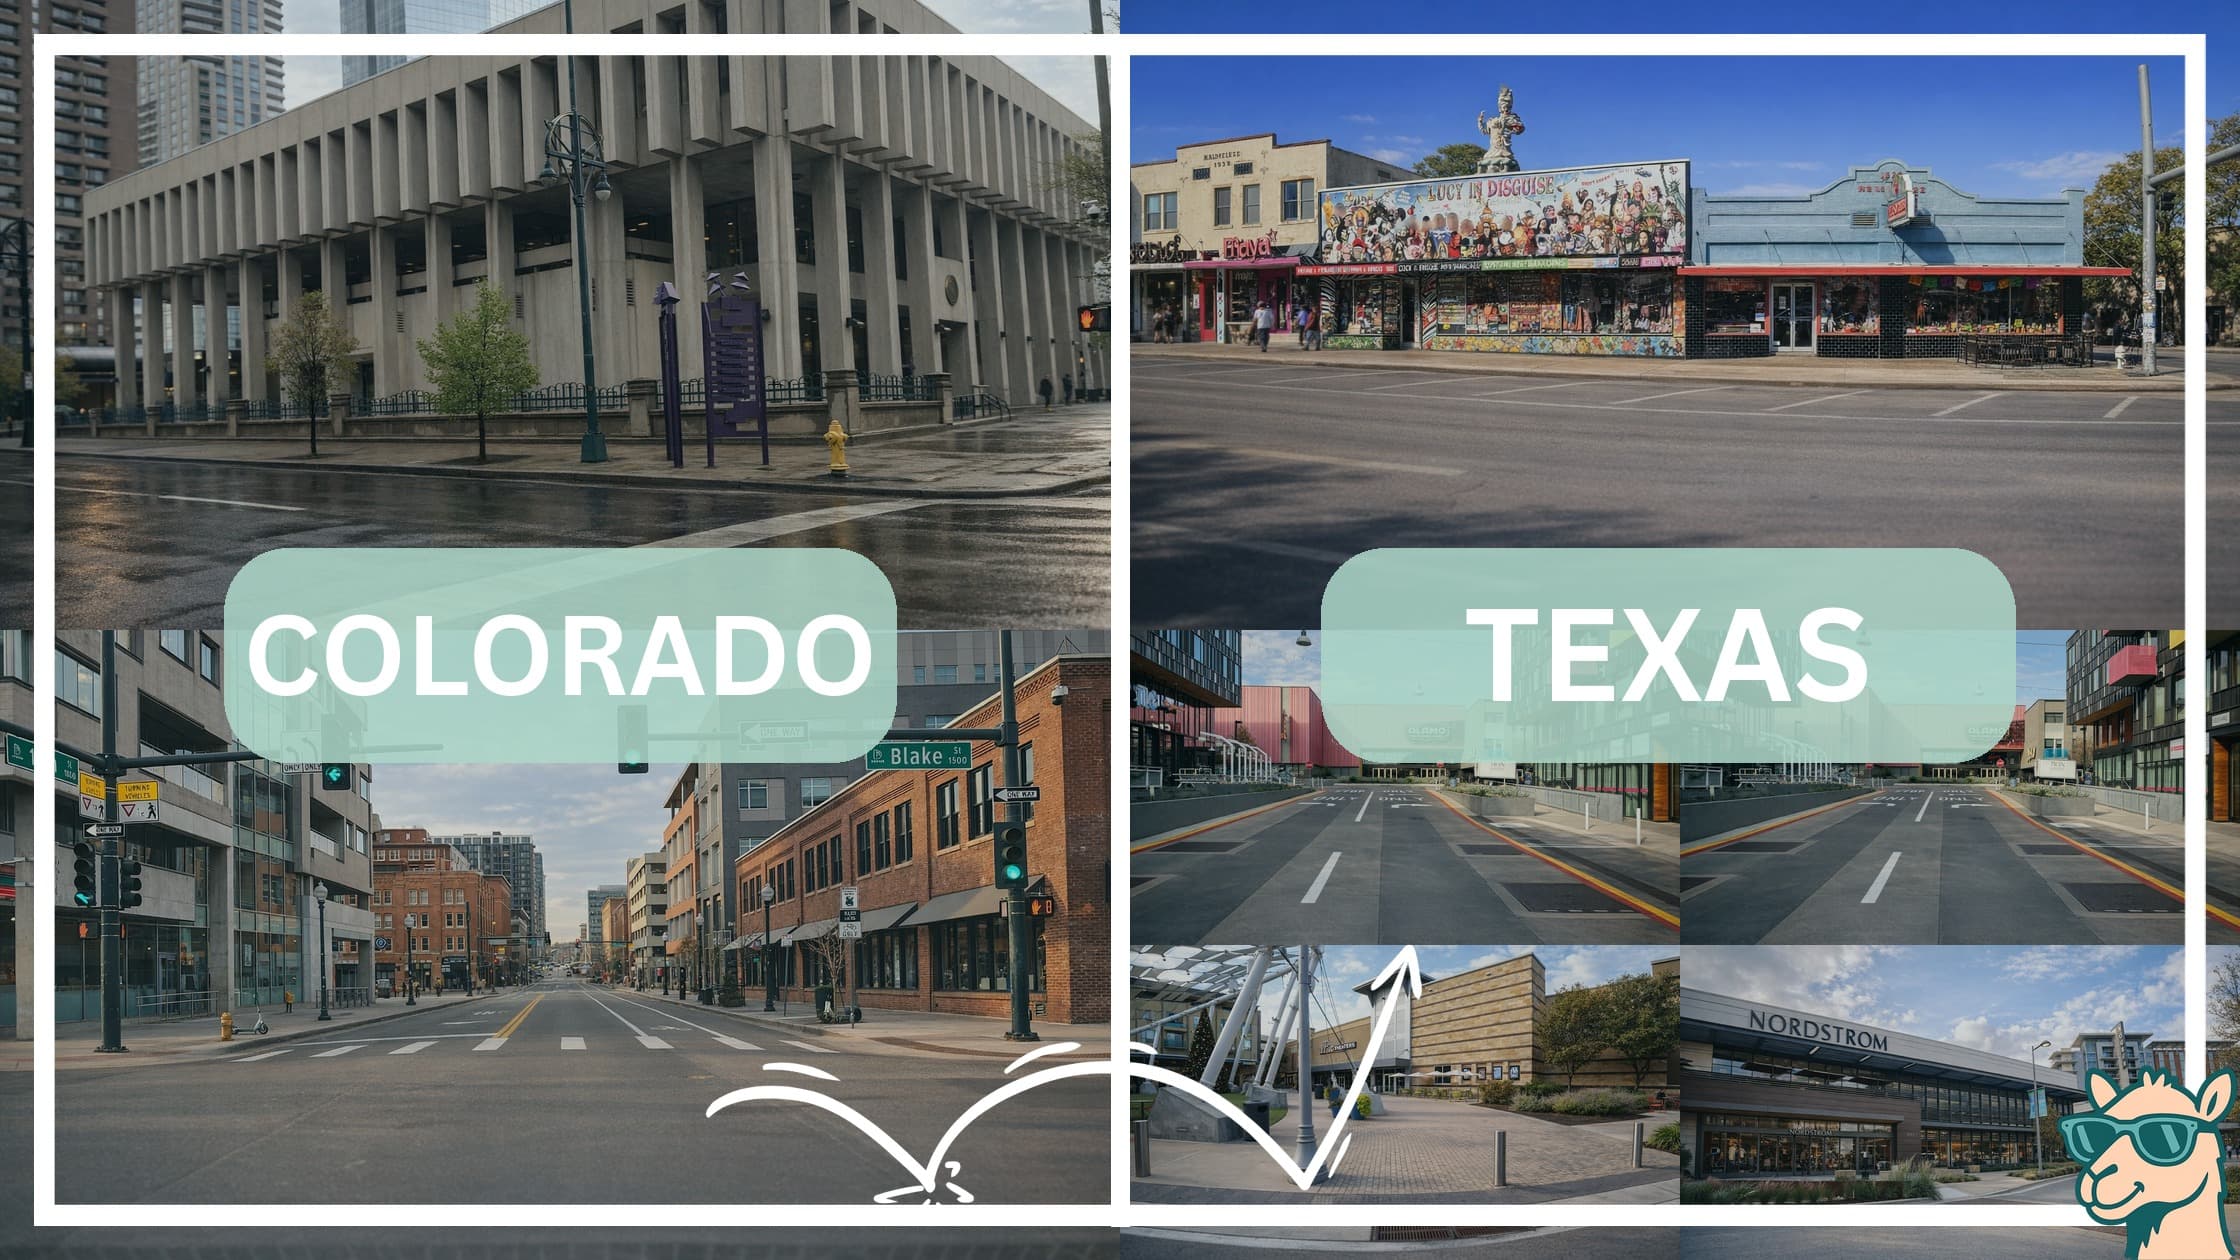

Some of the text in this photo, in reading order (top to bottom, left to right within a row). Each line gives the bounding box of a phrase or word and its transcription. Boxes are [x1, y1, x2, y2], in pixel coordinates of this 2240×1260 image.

[1427, 183, 1463, 201] LUCY
[1468, 181, 1482, 199] IN
[1487, 176, 1555, 198] DISGUISE
[891, 746, 943, 765] Blake
[1750, 1009, 1888, 1052] NORDSTROM
